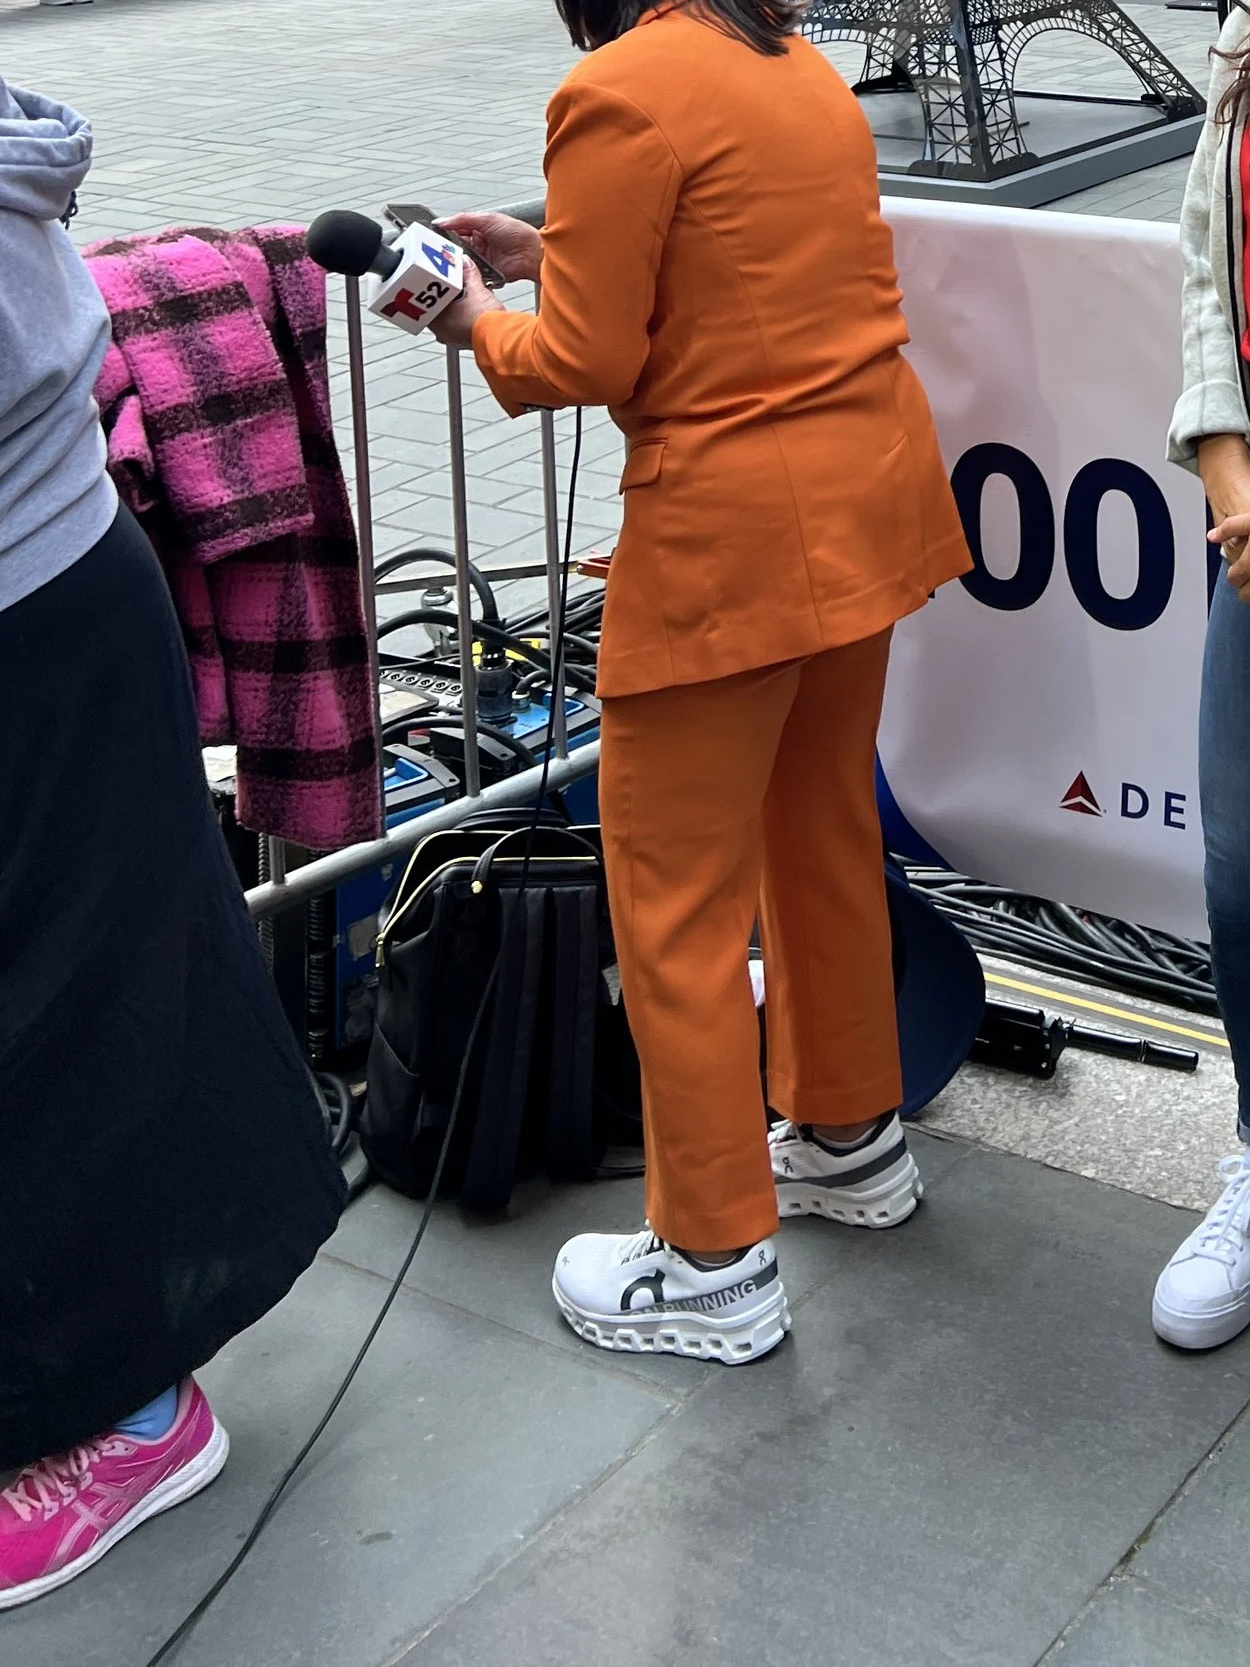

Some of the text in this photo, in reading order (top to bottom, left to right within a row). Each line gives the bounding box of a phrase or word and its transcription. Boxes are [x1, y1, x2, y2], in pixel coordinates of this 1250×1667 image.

[414, 281, 451, 309] 52
[950, 441, 1176, 632] 00
[663, 1278, 758, 1314] RUNNING
